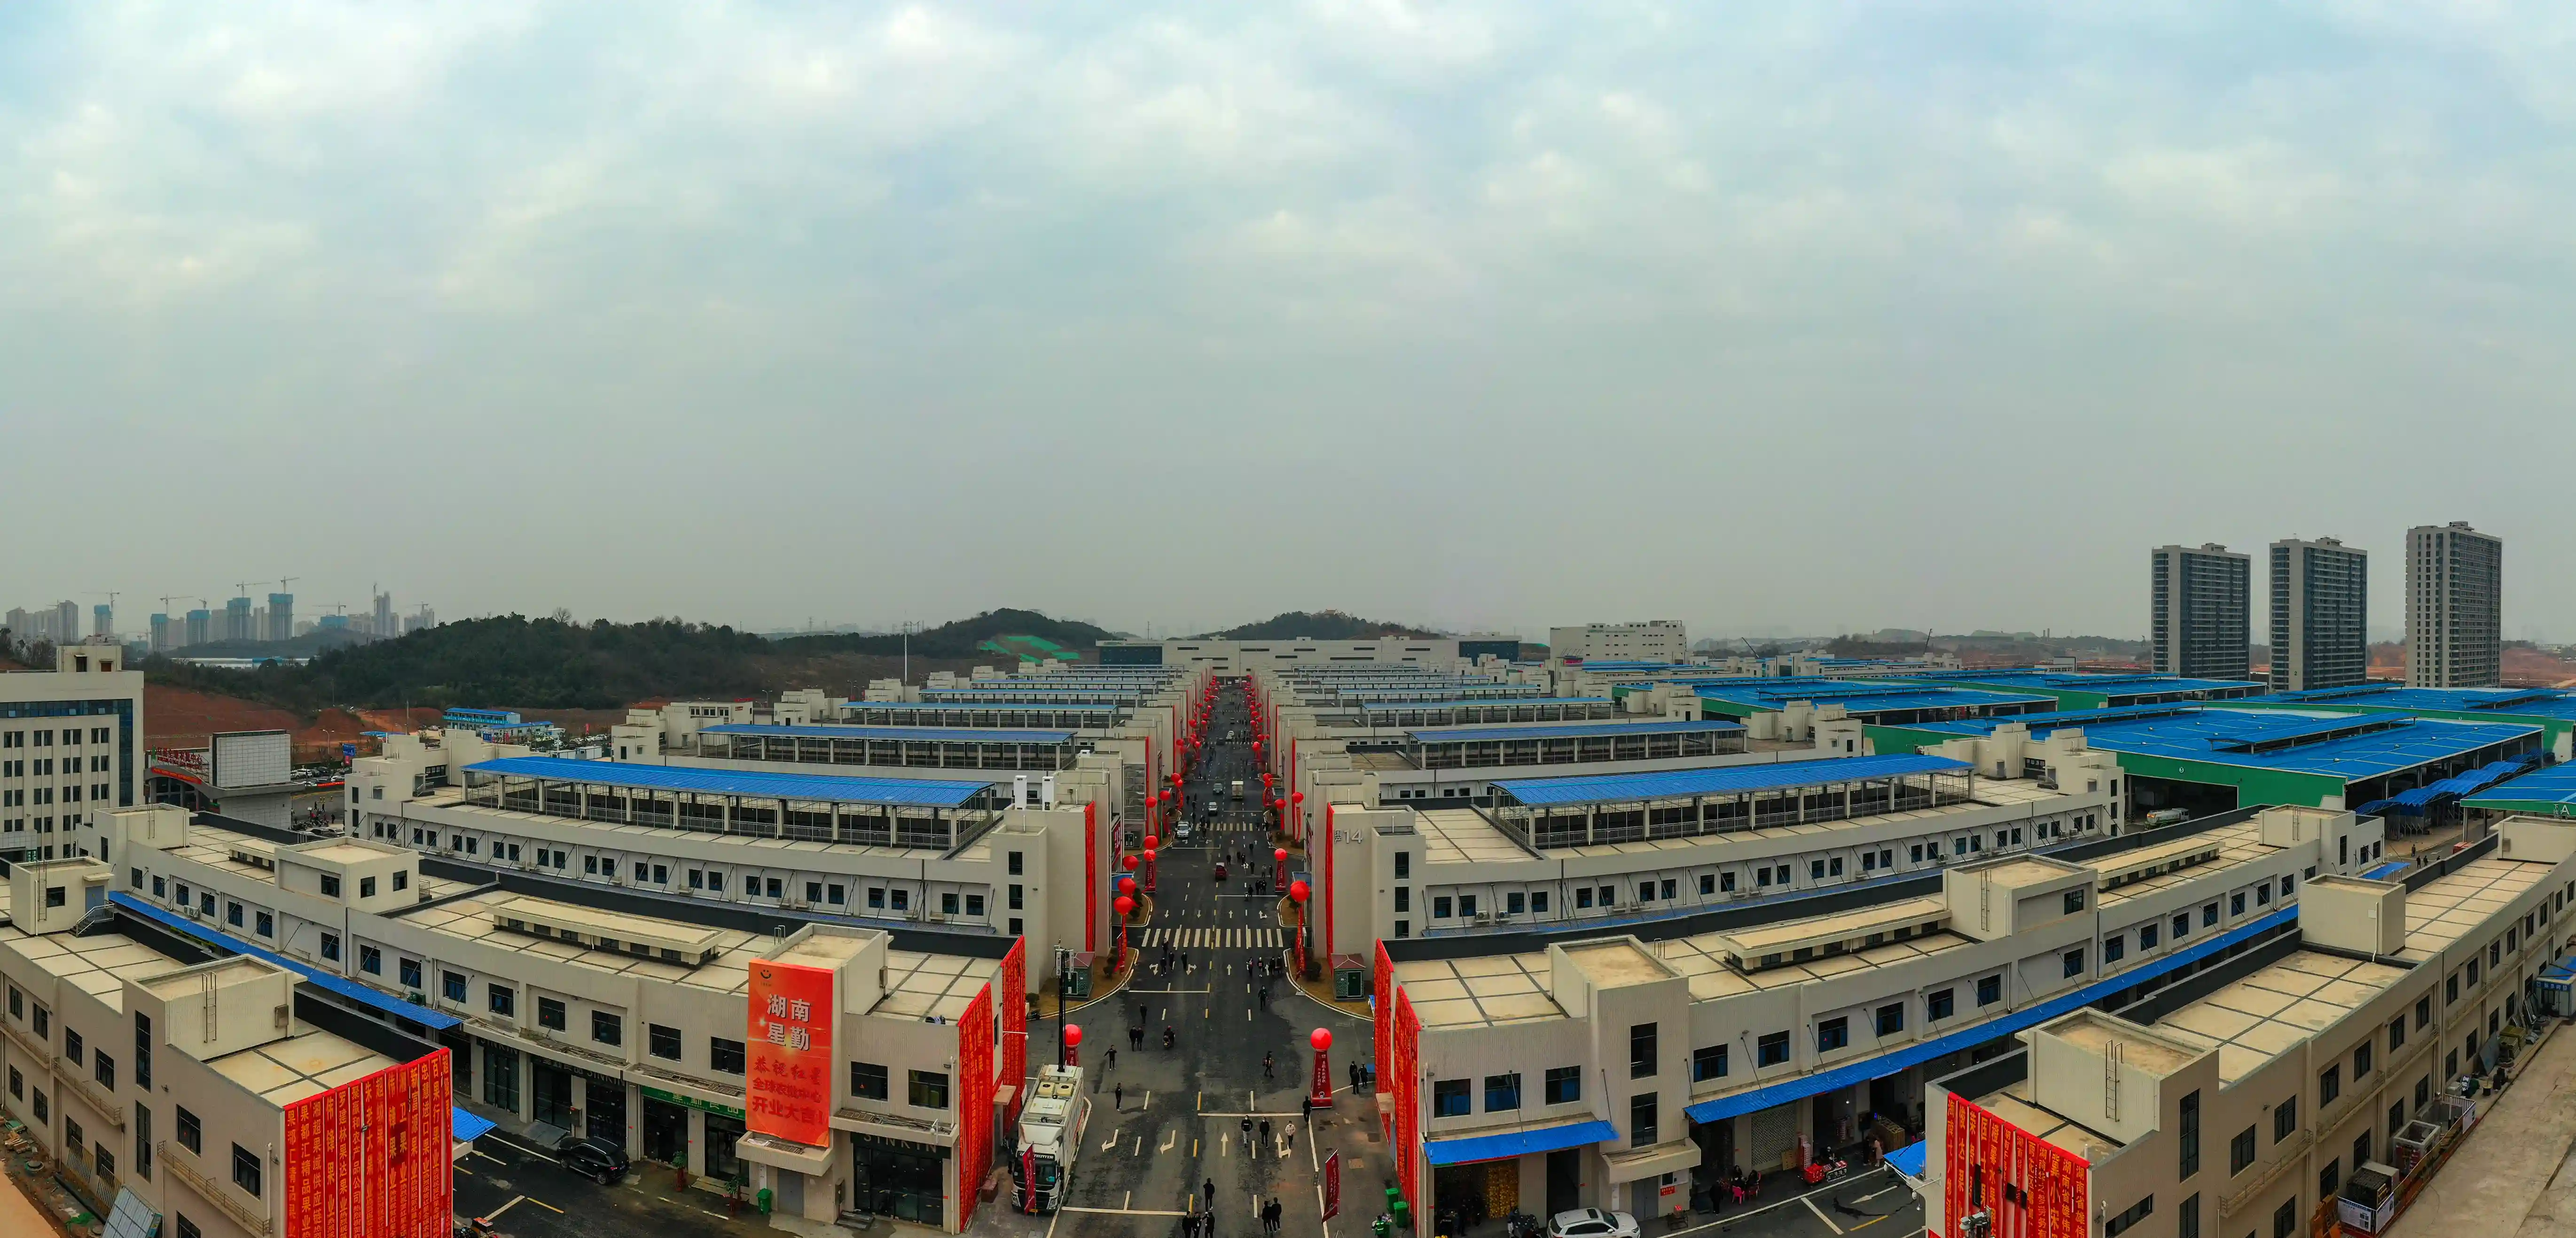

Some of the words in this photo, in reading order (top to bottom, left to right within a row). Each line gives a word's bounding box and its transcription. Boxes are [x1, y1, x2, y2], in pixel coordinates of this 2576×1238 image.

[1344, 829, 1363, 844] 14
[767, 993, 812, 1023] 湖南
[767, 1022, 810, 1051] 星勤
[753, 1055, 821, 1086] 恭祝红星
[752, 1077, 822, 1104] 全球农批中心
